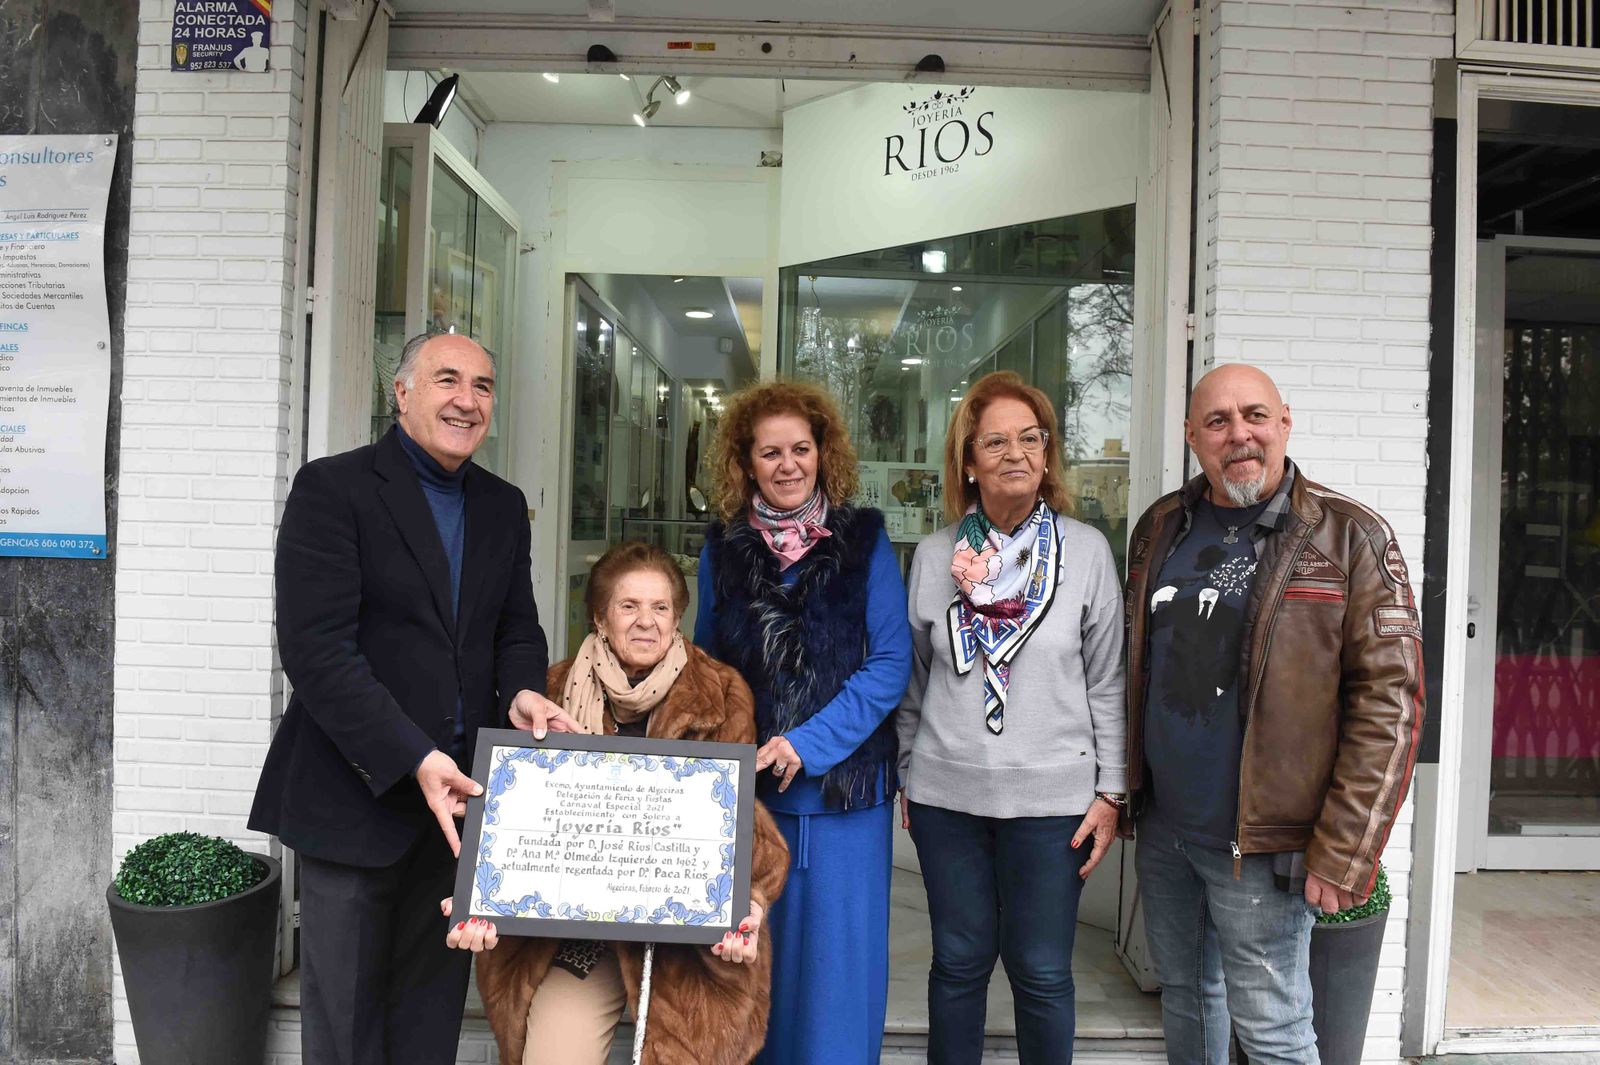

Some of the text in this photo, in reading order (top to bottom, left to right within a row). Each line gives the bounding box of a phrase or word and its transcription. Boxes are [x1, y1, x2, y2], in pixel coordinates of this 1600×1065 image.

[175, 1, 238, 13] ALARMA
[175, 14, 266, 26] CONECTADA
[174, 27, 247, 38] 24 HORAS
[192, 43, 233, 52] FRANJUS
[190, 61, 202, 70] 952
[218, 61, 232, 69] 537
[911, 105, 963, 129] JOYERÍA
[882, 110, 995, 177] RIOS
[911, 163, 960, 182] DESDE 1962
[23, 212, 36, 220] Luis
[69, 210, 87, 220] Pérez
[26, 231, 80, 240] PARTICULARES
[2, 253, 37, 261] Impuestos
[28, 281, 66, 289] Tributarias
[2, 291, 84, 300] Sociedades Mercantiles
[15, 302, 24, 310] de
[26, 301, 56, 310] Cuentas
[36, 385, 73, 393] Inmuebles
[29, 395, 39, 403] de
[40, 395, 77, 404] Inmuebles
[14, 445, 46, 454] Abusivas
[41, 539, 58, 548] 606
[60, 540, 76, 549] 090
[78, 540, 94, 549] 372
[574, 782, 633, 793] Ayuntamiento
[635, 785, 646, 793] de
[647, 786, 685, 796] Algeciras
[556, 790, 601, 801] Delegación
[603, 793, 613, 801] de
[614, 793, 635, 802] Feria
[645, 794, 672, 803] Fiestas
[559, 800, 665, 812] Carnaval Especial 2021
[544, 807, 615, 819] Establecimiento
[642, 812, 671, 821] Solera
[518, 835, 561, 847] Fundada
[566, 841, 585, 851] por
[588, 839, 598, 850] D.
[597, 839, 624, 854] José
[654, 841, 691, 854] Castilla
[693, 846, 701, 857] y
[521, 849, 541, 860] Ana
[563, 851, 605, 863] Olmedo
[608, 853, 658, 867] Izquierdo
[661, 858, 673, 866] en
[676, 857, 697, 869] 1962
[702, 860, 710, 871] y
[501, 862, 561, 874] actualmente
[565, 865, 614, 877] regentada
[617, 869, 635, 880] por
[654, 867, 681, 879] Paca
[663, 885, 671, 894] de
